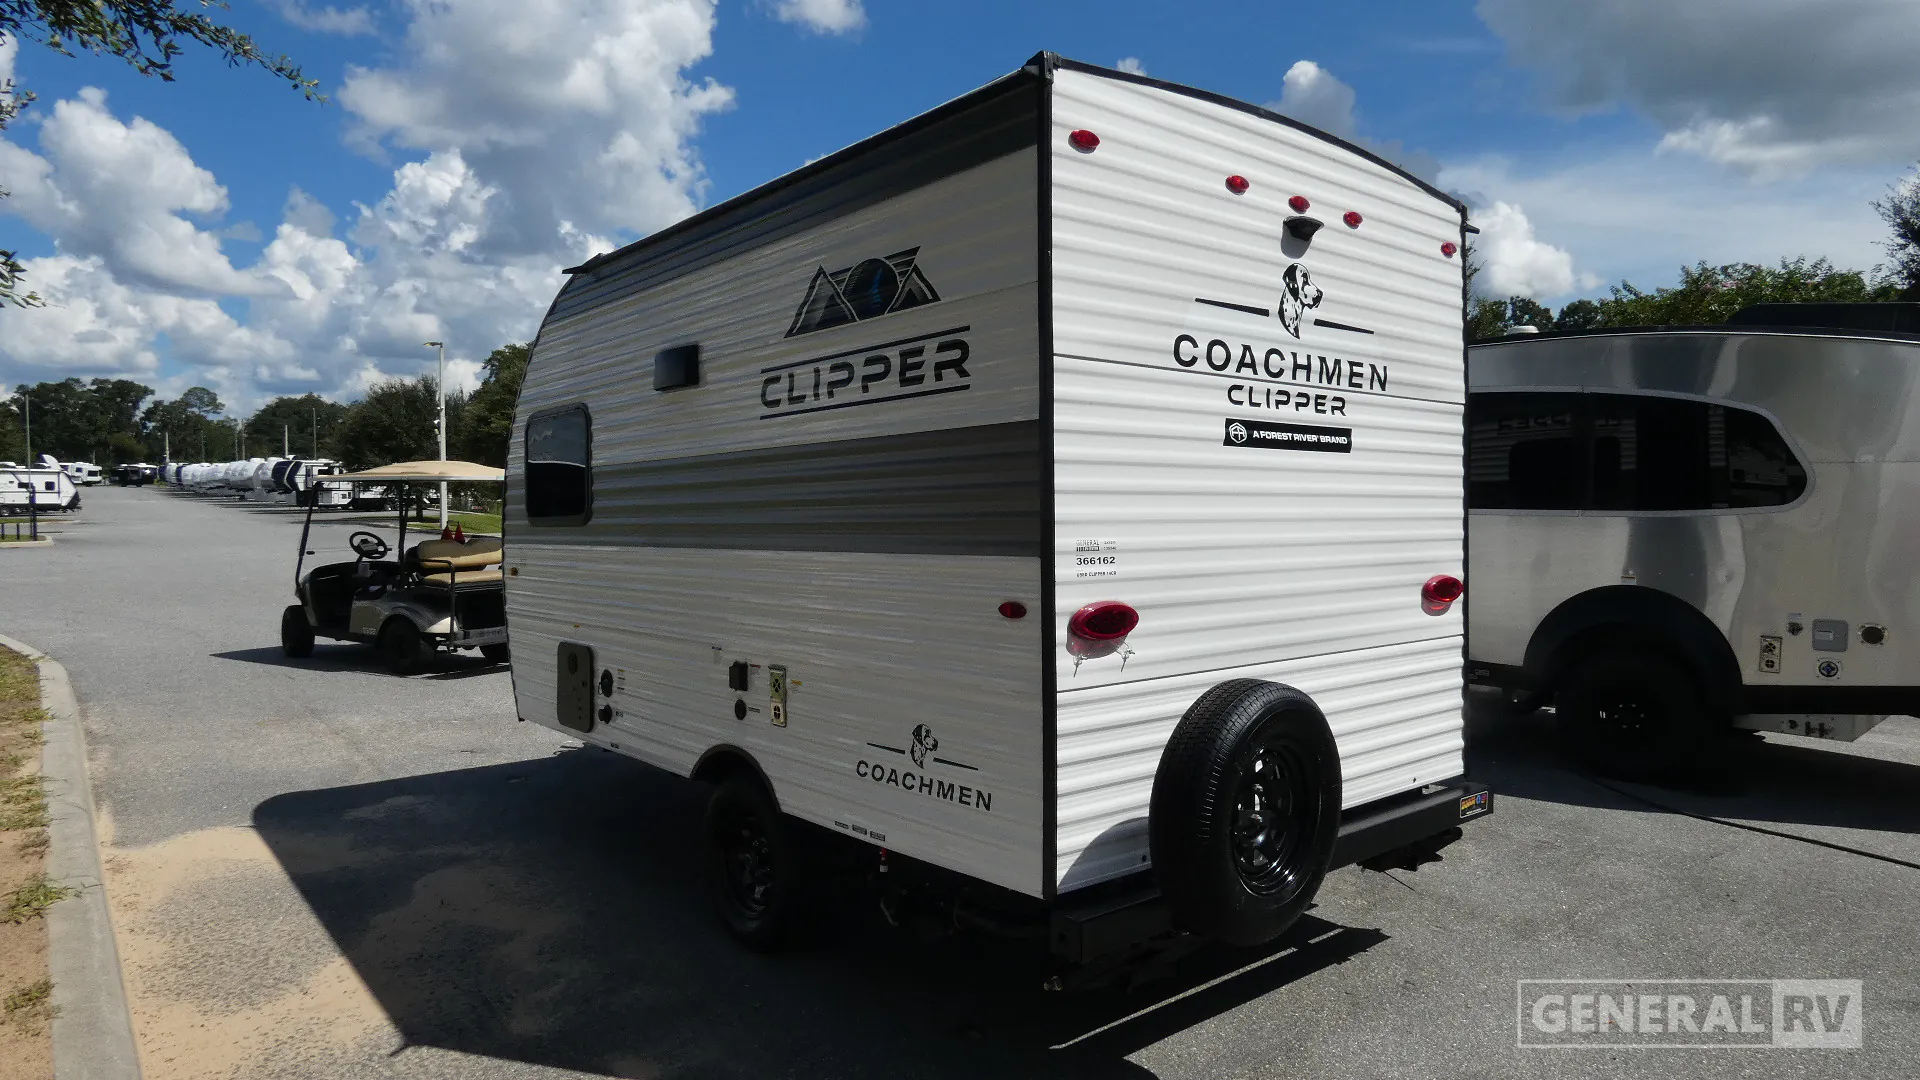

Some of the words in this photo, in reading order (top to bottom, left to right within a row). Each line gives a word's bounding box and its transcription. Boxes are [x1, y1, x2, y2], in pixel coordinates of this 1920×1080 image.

[761, 338, 971, 408] CLIPPER
[1173, 334, 1388, 391] COACHMEN
[1227, 384, 1347, 416] CLIPPER
[1252, 430, 1260, 438] A
[1260, 431, 1293, 440] FOREST
[1293, 434, 1319, 443] RIVER
[1319, 435, 1348, 444] BRAND
[1076, 556, 1116, 566] 366162
[856, 759, 992, 811] COACHMEN
